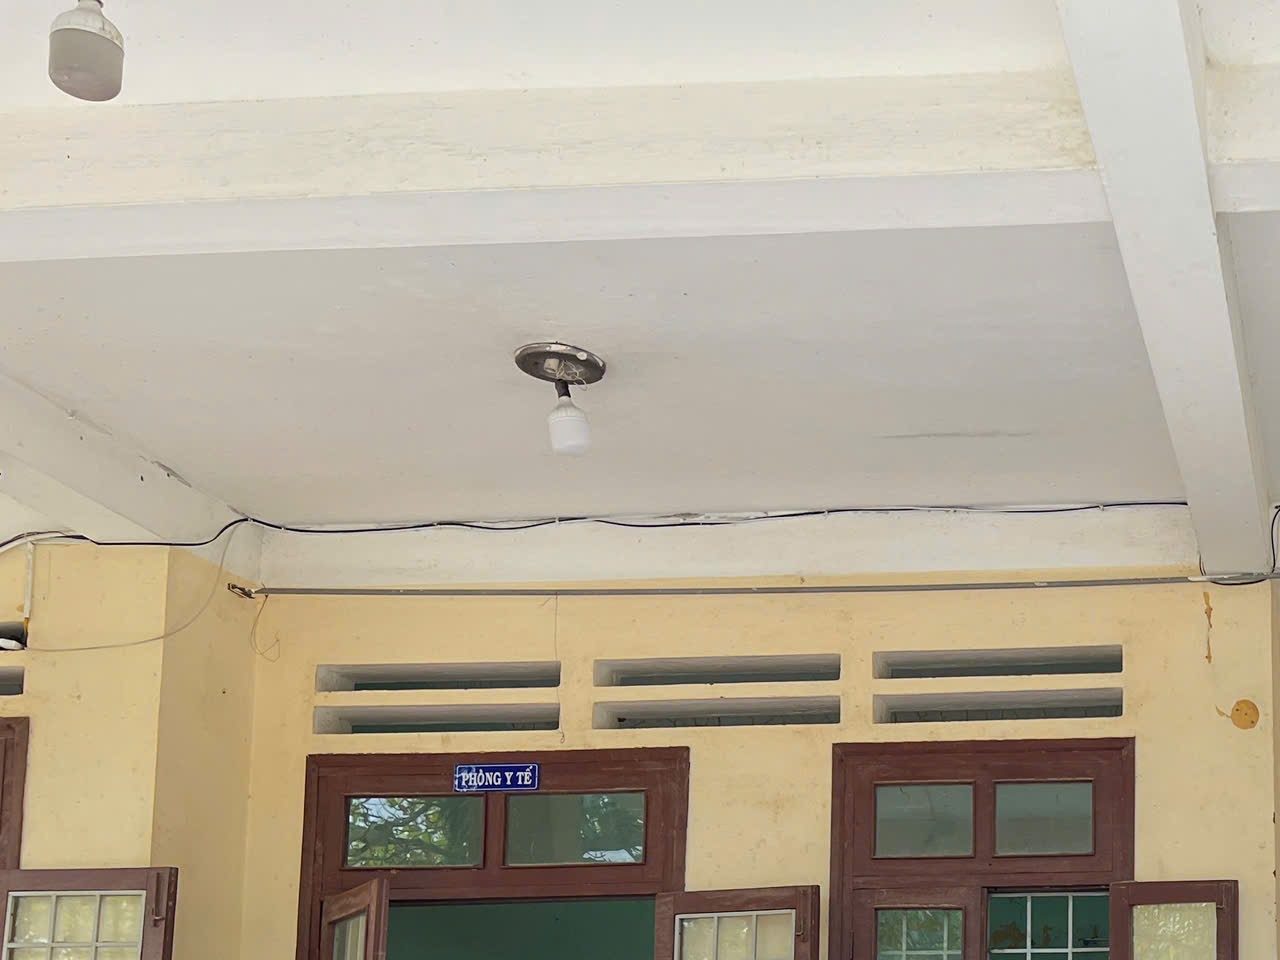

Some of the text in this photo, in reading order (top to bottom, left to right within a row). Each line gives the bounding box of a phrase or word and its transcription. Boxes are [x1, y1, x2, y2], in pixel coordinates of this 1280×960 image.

[461, 765, 532, 786] PHÒNG Y TẾ
